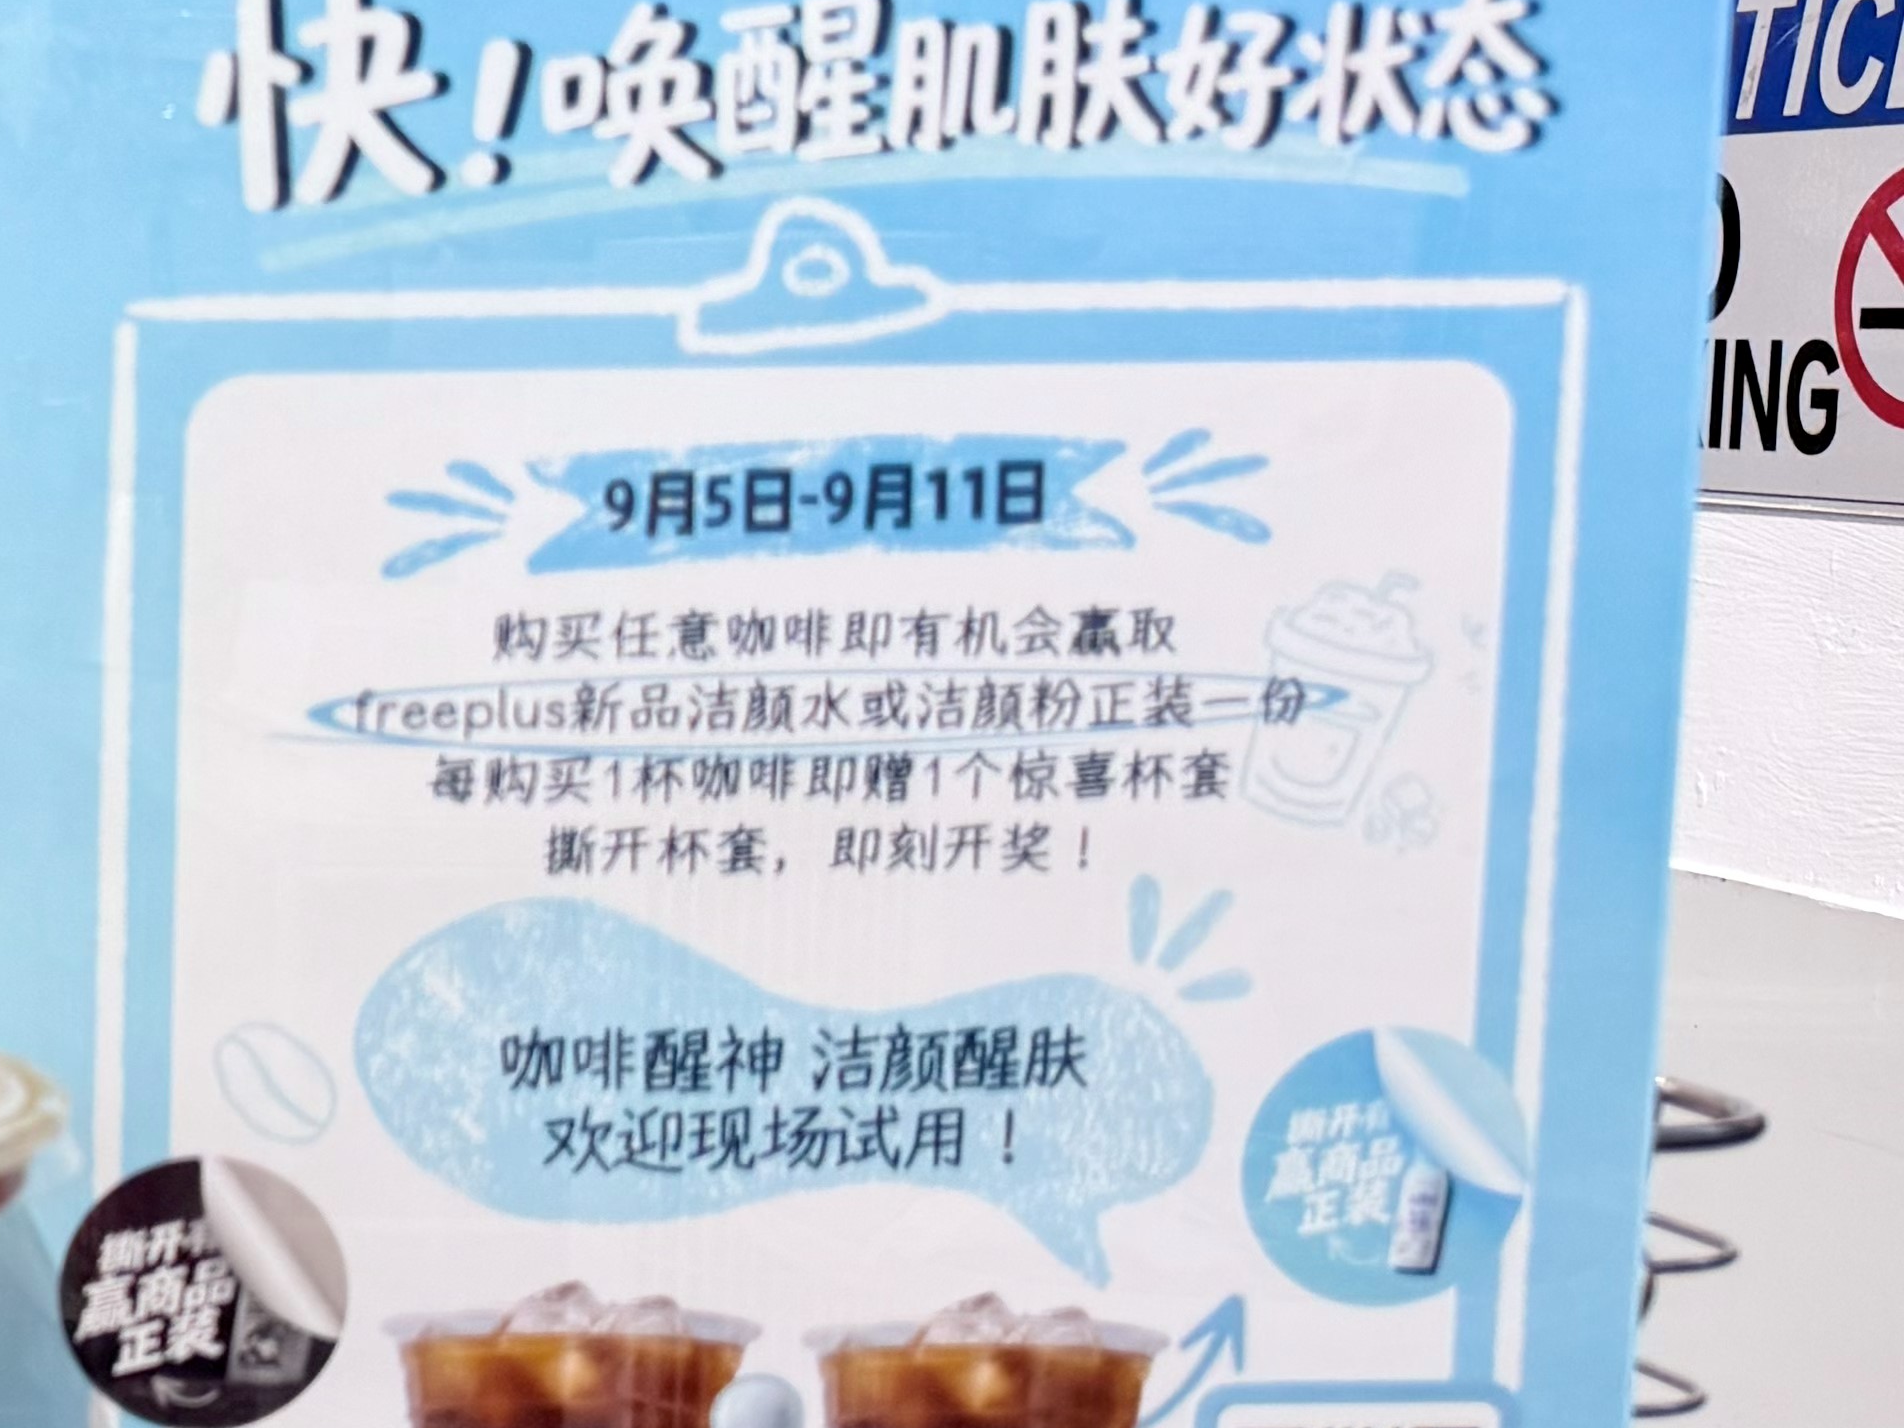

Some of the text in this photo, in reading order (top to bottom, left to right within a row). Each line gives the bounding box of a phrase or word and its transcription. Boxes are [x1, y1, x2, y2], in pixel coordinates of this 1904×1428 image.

[1698, 338, 1840, 456] ING
[602, 460, 1049, 537] 9月5日-9月11日
[492, 606, 1178, 661] 购买任意咖啡即有机会赢取
[352, 680, 1308, 736] freeplus新品洁颜水或洁颜粉正装一份
[427, 749, 1233, 806] 每购买1杯咖啡即赠1个惊喜杯套
[543, 822, 1094, 877] 撕开杯套，即刻开奖！
[500, 1023, 1088, 1095] 咖啡醒神 洁颜醒肤
[542, 1105, 1019, 1174] 欢迎现场试用！
[112, 1306, 225, 1377] 正装
